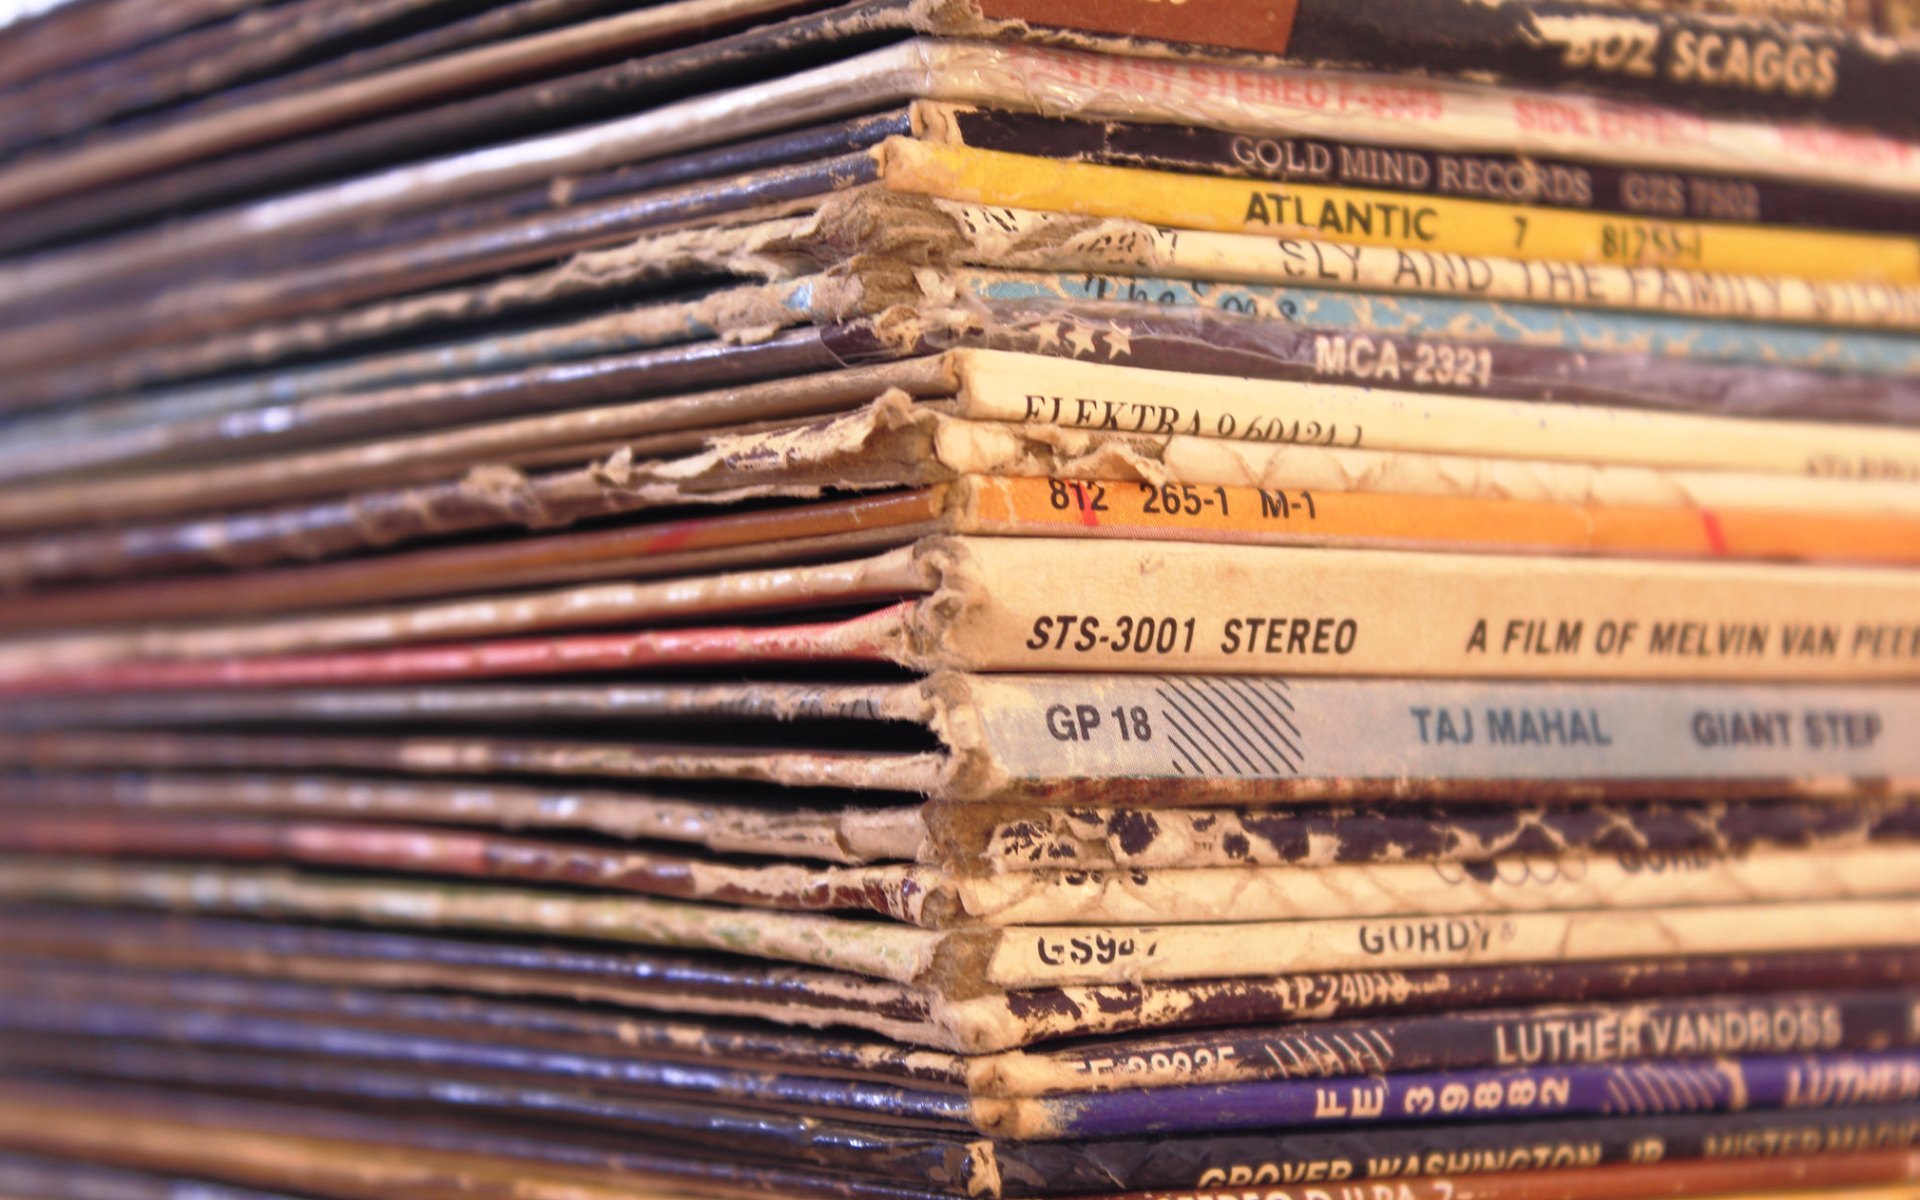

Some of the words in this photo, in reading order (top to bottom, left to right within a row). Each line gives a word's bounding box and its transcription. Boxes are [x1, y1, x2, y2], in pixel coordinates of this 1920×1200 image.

[1671, 29, 1837, 96] SCAGGS
[1232, 136, 1332, 173] GOLD
[1339, 145, 1430, 186] MIND
[1438, 156, 1592, 203] RECORDS
[1244, 191, 1437, 241] ATLANTIC
[1512, 216, 1528, 249] 7
[1278, 238, 1362, 282] SLY
[1395, 250, 1494, 292] AND
[1519, 260, 1606, 301] THE
[1314, 334, 1493, 388] MCA-2321
[1023, 395, 1201, 436] ELEKTRA
[1048, 477, 1109, 512] 812
[1139, 481, 1230, 517] 265-1
[1259, 487, 1316, 520] M-1
[1026, 615, 1197, 653] STS-3001
[1220, 617, 1358, 655] STEREO
[1466, 618, 1488, 655] A
[1502, 619, 1583, 656] FILM
[1595, 620, 1638, 656] OF
[1648, 621, 1769, 657] MELVIN
[1781, 622, 1841, 657] VAN
[1045, 704, 1101, 742] GP
[1110, 705, 1153, 742] 18
[1410, 706, 1475, 746] TAJ
[1486, 707, 1613, 747] MAHAL
[1690, 710, 1795, 749] GIANT
[1803, 710, 1884, 749] STEP
[1495, 1016, 1643, 1065] LUTHER
[1649, 1004, 1843, 1055] VANDROSS
[1314, 1086, 1386, 1119] FE
[1404, 1076, 1570, 1116] 39882
